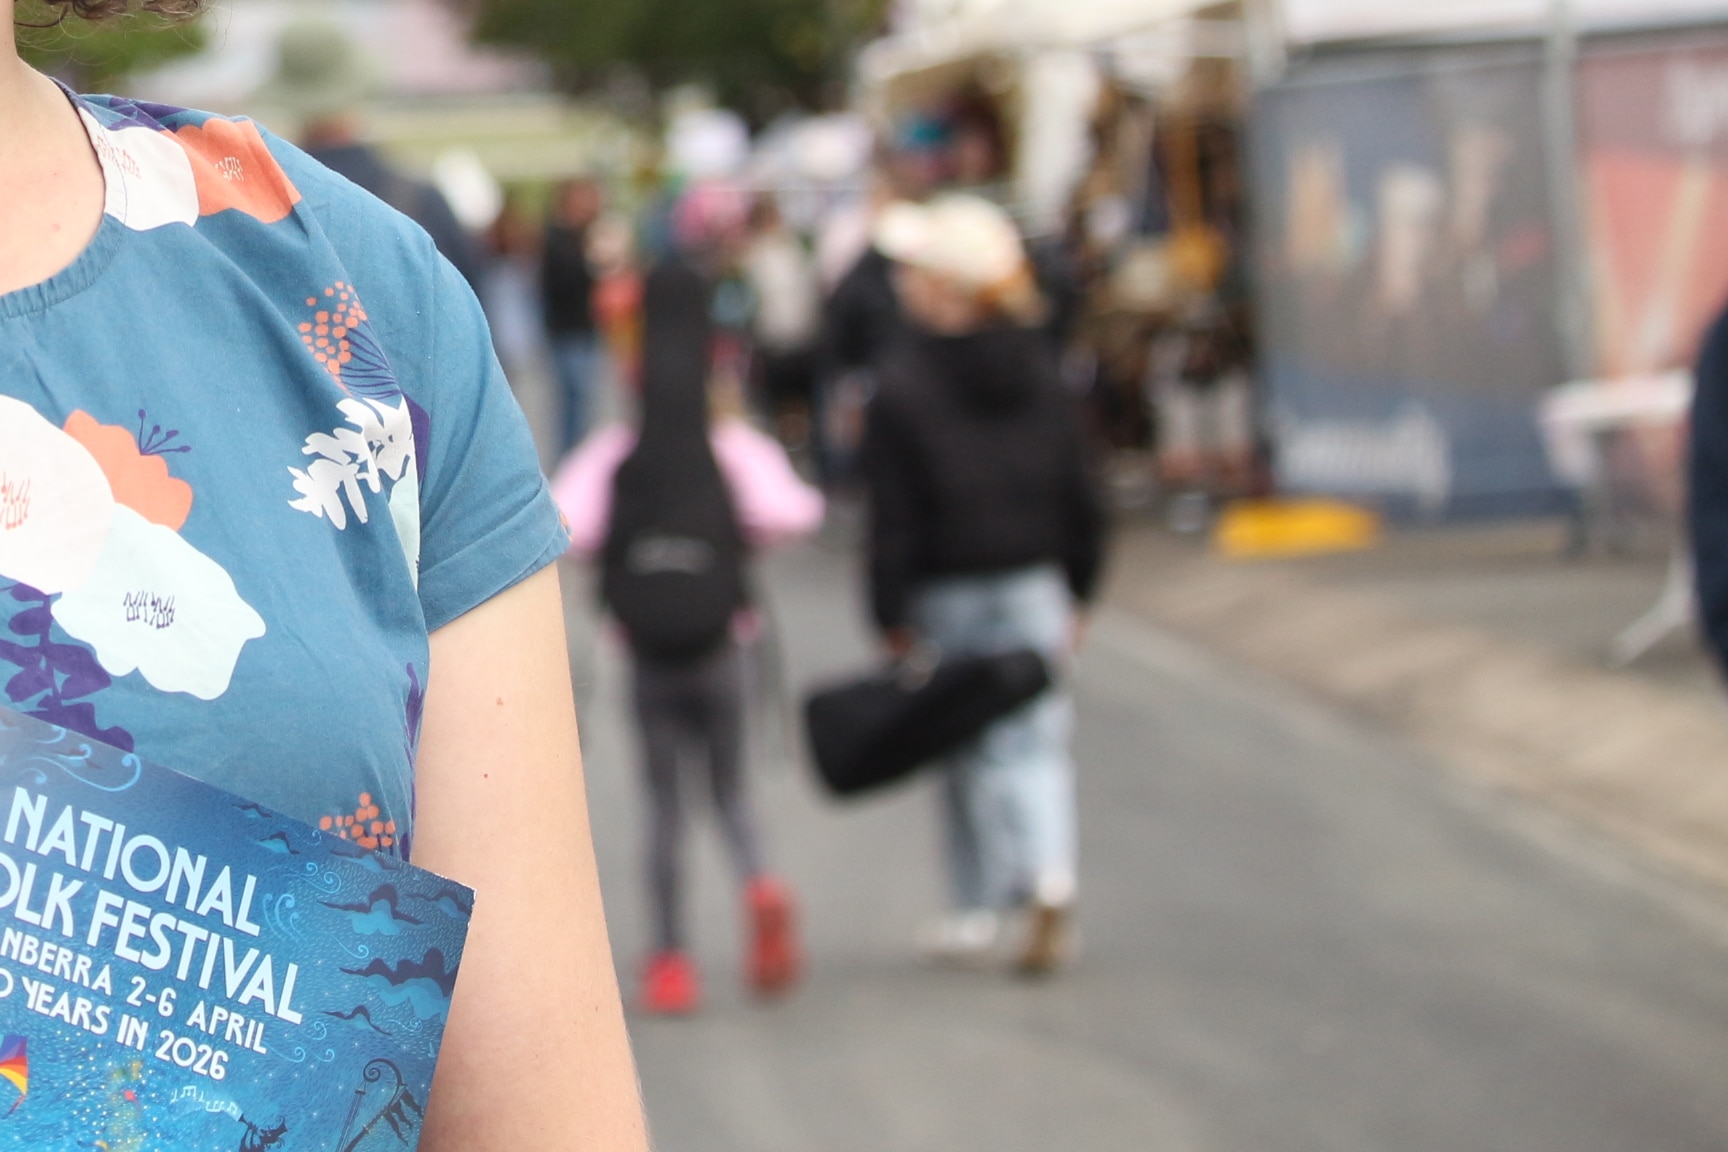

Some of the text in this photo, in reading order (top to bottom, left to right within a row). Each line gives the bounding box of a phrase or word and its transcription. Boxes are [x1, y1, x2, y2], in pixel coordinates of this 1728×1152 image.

[4, 787, 260, 936] NATIONAL
[86, 889, 303, 1025] FESTIVAL
[127, 976, 177, 1017] 2-6
[186, 1000, 268, 1054] APRIL
[21, 976, 112, 1034] YEARS
[116, 1014, 148, 1050] IN
[155, 1030, 229, 1080] 2026
